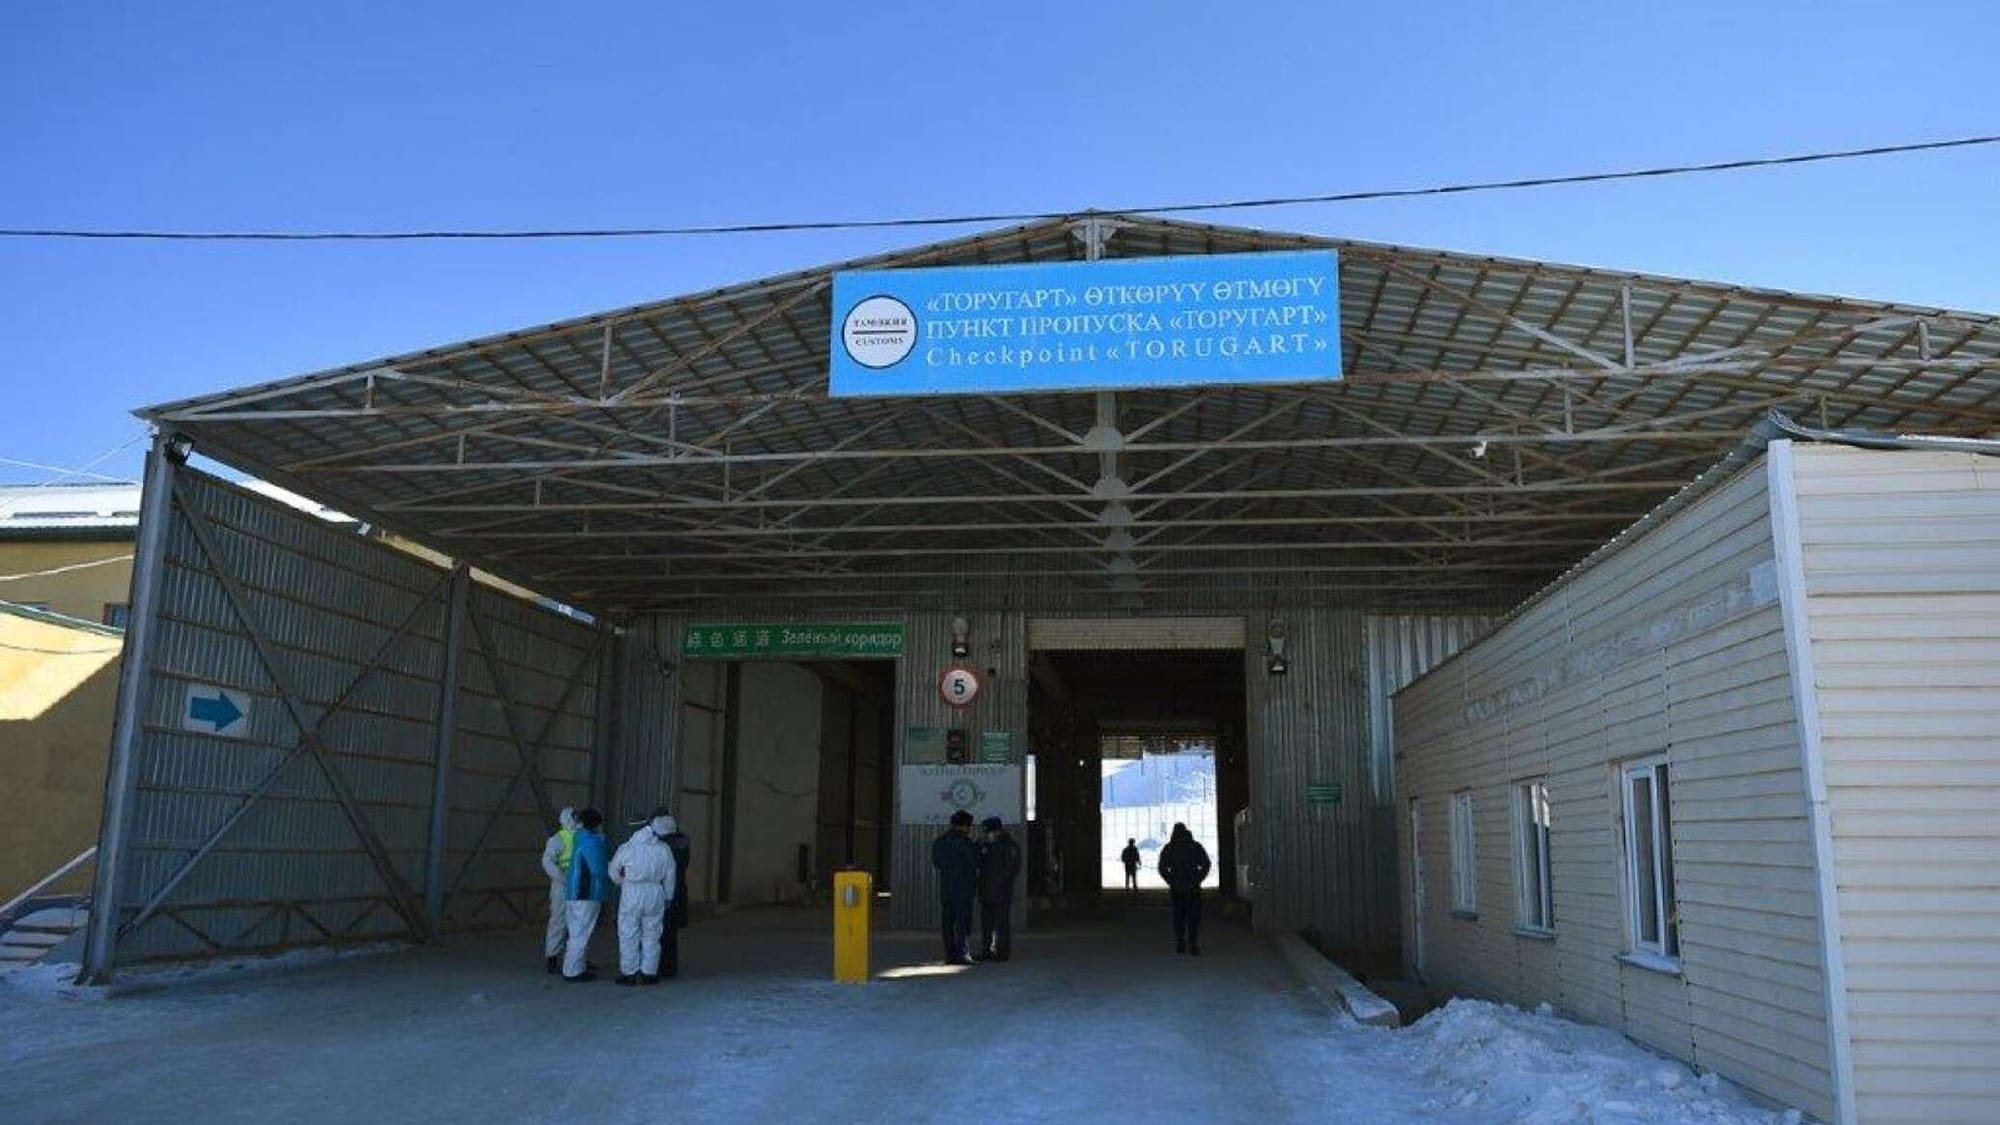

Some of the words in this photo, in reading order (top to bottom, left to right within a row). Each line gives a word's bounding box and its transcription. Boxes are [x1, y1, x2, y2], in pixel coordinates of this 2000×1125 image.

[927, 289, 1077, 313] «ТОРУГАРТ»
[926, 317, 1014, 339] ПУНКТ
[1020, 312, 1162, 337] ПРОПУСКА
[1169, 304, 1327, 330] «ТОРУГАРТ»
[855, 336, 904, 347] CUSTOMS
[926, 341, 1096, 369] Checkpoint
[952, 678, 966, 695] 5
